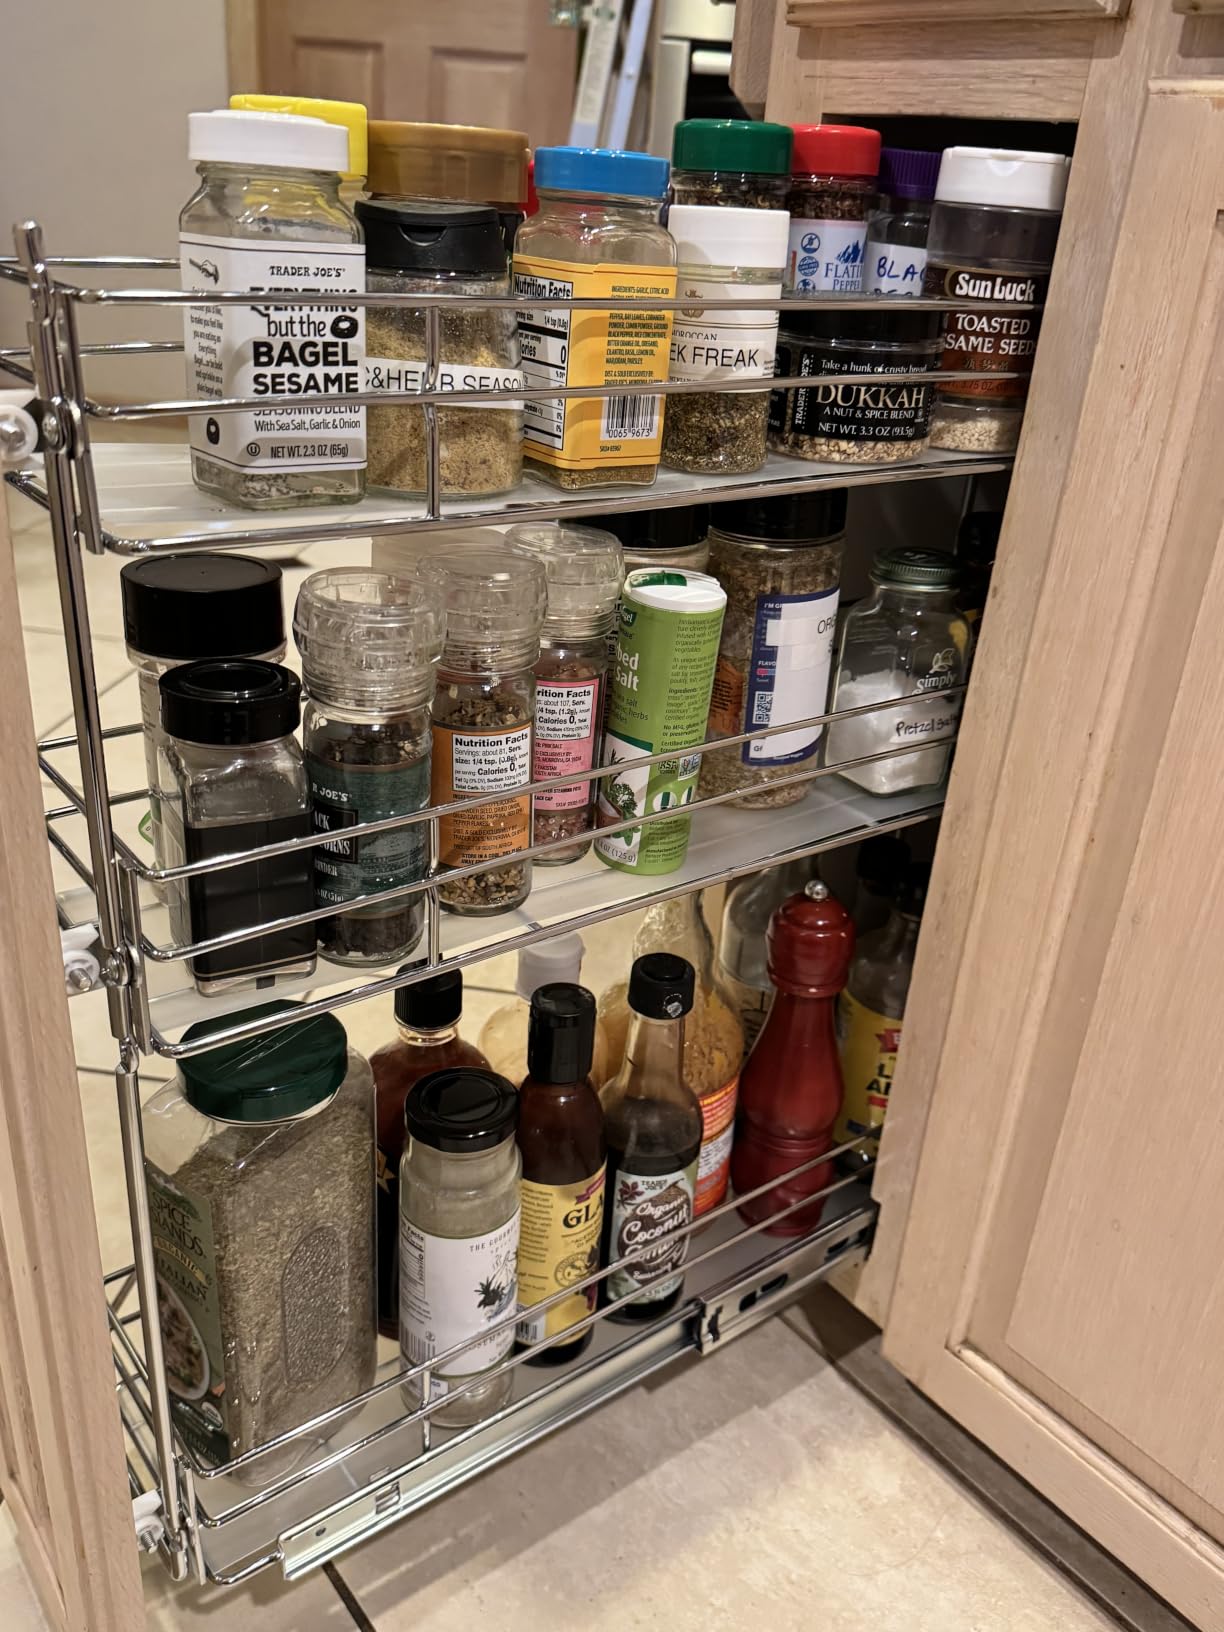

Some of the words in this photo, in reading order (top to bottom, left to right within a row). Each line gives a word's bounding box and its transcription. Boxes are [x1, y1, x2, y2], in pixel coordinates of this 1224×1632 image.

[270, 265, 310, 276] TRADER
[313, 267, 342, 277] JOE'S
[514, 275, 546, 298] Nutrition
[548, 281, 571, 299] Facts
[955, 273, 992, 298] Sun
[993, 277, 1035, 301] Luck
[267, 313, 298, 337] but
[298, 313, 327, 337] the
[955, 314, 1030, 335] TOASTED
[946, 333, 994, 353] SAME
[253, 341, 358, 367] BAGEL
[561, 345, 567, 364] 0
[693, 346, 760, 367] FREAK
[821, 360, 840, 370] Take
[841, 362, 848, 371] a
[850, 361, 872, 373] hunk
[252, 373, 359, 395] SESAME
[816, 385, 926, 409] DUKKAH
[833, 407, 853, 418] NUT
[855, 408, 863, 418] &
[865, 409, 888, 419] SPICE
[890, 410, 915, 420] BLEND
[254, 420, 275, 432] With
[275, 419, 290, 430] Sea
[291, 418, 309, 432] Salt,
[309, 418, 331, 430] Garlic
[331, 419, 339, 429] &
[340, 418, 360, 429] Onion
[818, 422, 838, 433] NET
[839, 424, 856, 435] WT.
[860, 425, 874, 436] 3.3
[875, 425, 890, 436] OZ
[891, 426, 915, 438] (93.5g)
[609, 430, 628, 438] 0065
[631, 429, 651, 437] 9673
[271, 447, 286, 459] NET
[287, 446, 302, 458] WT.
[303, 445, 316, 457] 2.3
[318, 445, 328, 457] OZ
[330, 444, 348, 458] (65g)
[616, 667, 640, 691] Salt
[566, 689, 591, 698] Facts
[545, 707, 558, 716] tsp.
[538, 715, 568, 725] Calories
[895, 718, 935, 737] Pretzel
[455, 737, 503, 748] Nutrition
[505, 732, 528, 746] Facts
[455, 747, 481, 757] Servings:
[481, 748, 498, 757] about
[455, 756, 471, 764] size:
[472, 758, 482, 766] 1/4
[484, 758, 498, 766] tsp.
[477, 766, 508, 776] Calories
[320, 788, 349, 801] JOE'S
[611, 848, 627, 860] (125
[636, 1194, 688, 1220] Organic
[623, 1203, 689, 1244] Coconut
[470, 1242, 486, 1253] THE
